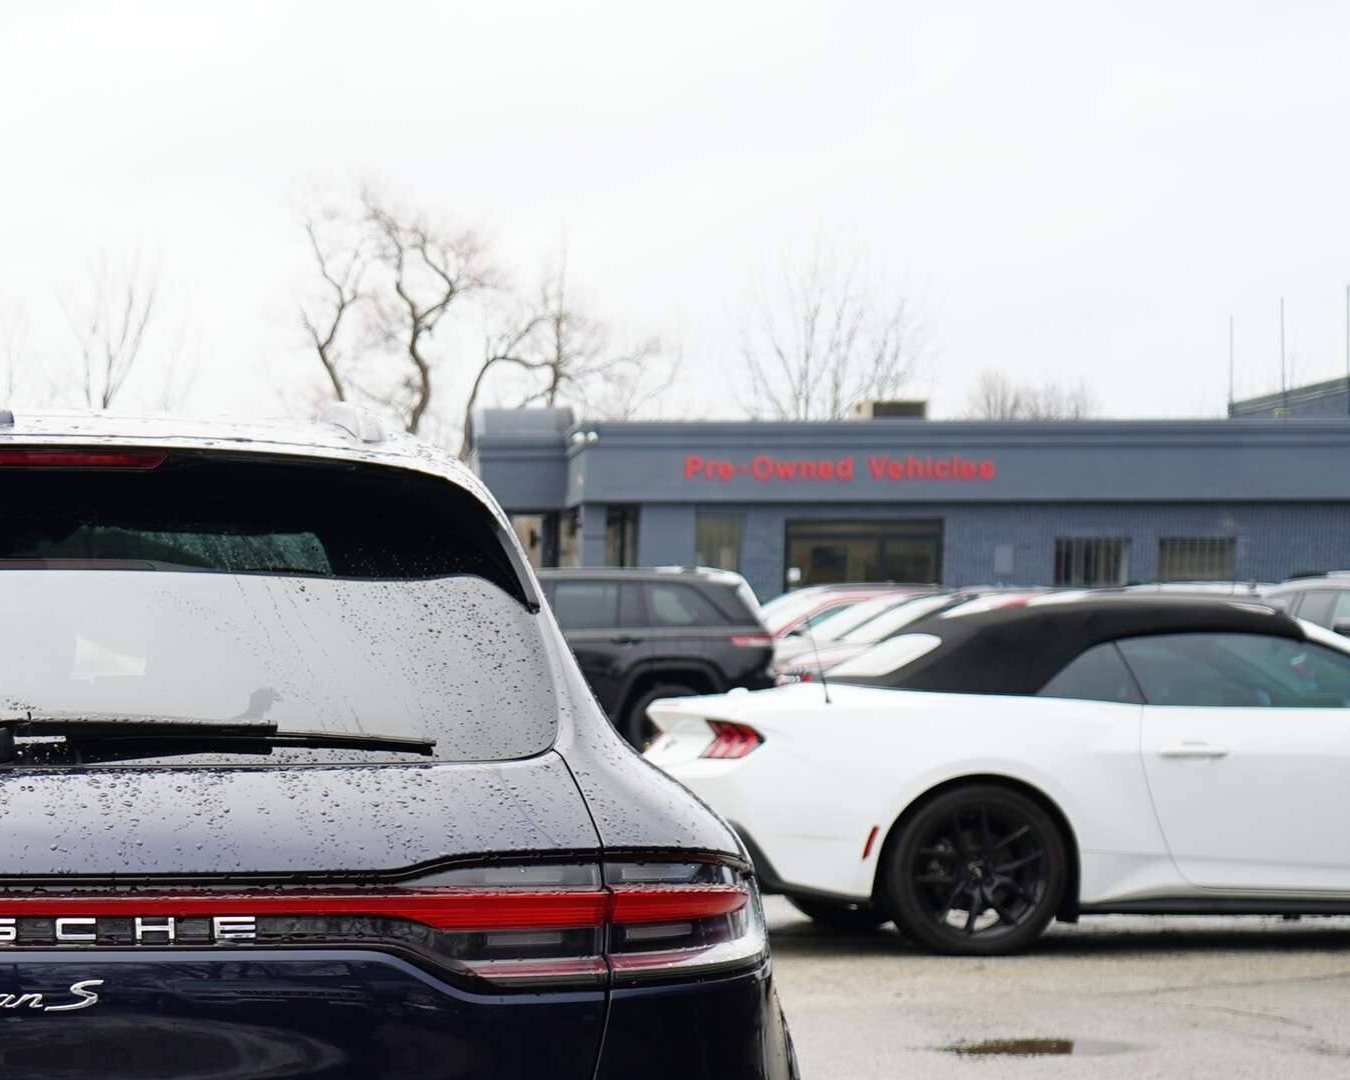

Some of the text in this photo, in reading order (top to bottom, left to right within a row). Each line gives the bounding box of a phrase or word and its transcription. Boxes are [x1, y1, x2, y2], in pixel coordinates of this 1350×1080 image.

[684, 455, 995, 480] Pre-Owned Vehicles
[43, 979, 104, 1012] S
